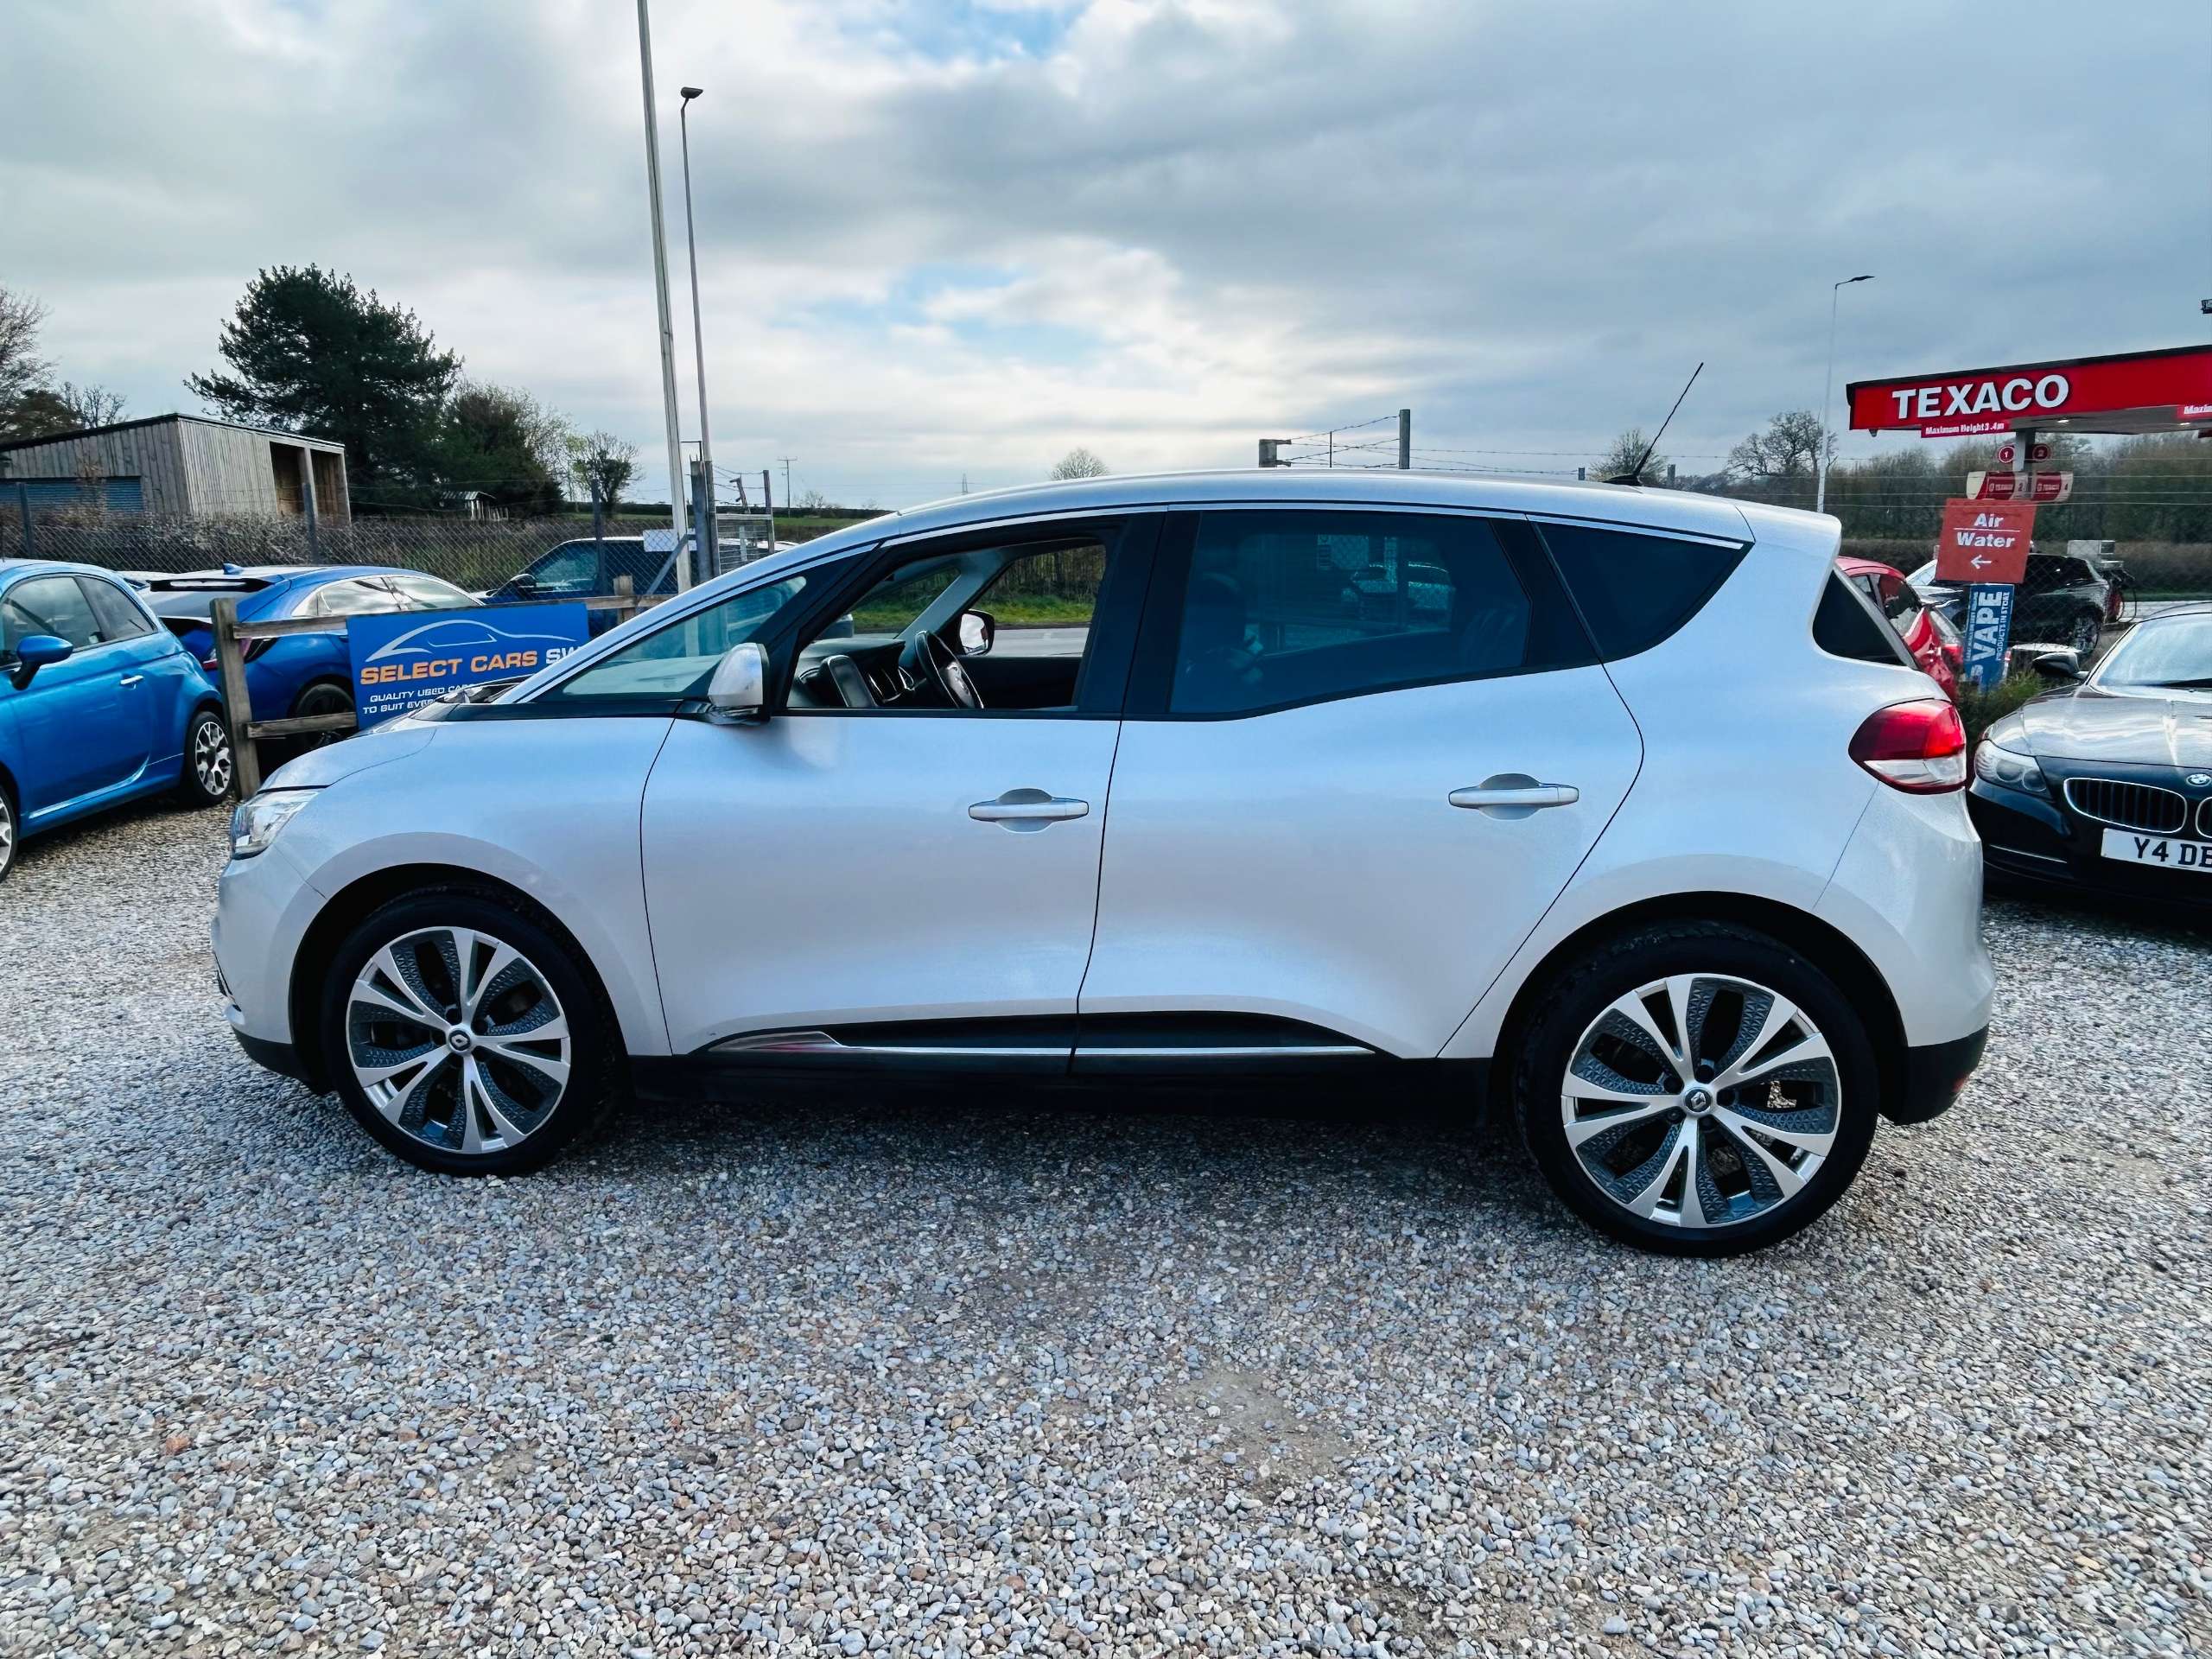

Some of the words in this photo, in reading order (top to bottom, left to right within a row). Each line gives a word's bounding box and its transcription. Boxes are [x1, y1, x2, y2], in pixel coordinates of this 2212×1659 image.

[1892, 374, 2069, 420] TEXACO
[1926, 426, 1960, 435] Maximum
[1961, 423, 1984, 433] Height
[1974, 513, 2004, 528] Air
[1957, 532, 2016, 548] Water
[2001, 592, 2010, 614] STORE
[1971, 592, 2002, 661] VAPE
[2000, 614, 2007, 623] IN
[1996, 624, 2006, 661] PRODUCTS
[360, 658, 463, 685] SELECT
[471, 650, 537, 672] CARS
[370, 690, 415, 702] QUALITY
[417, 687, 446, 697] USED
[363, 706, 378, 715] TO
[380, 702, 404, 712] SUIT
[2134, 836, 2169, 861] Y4
